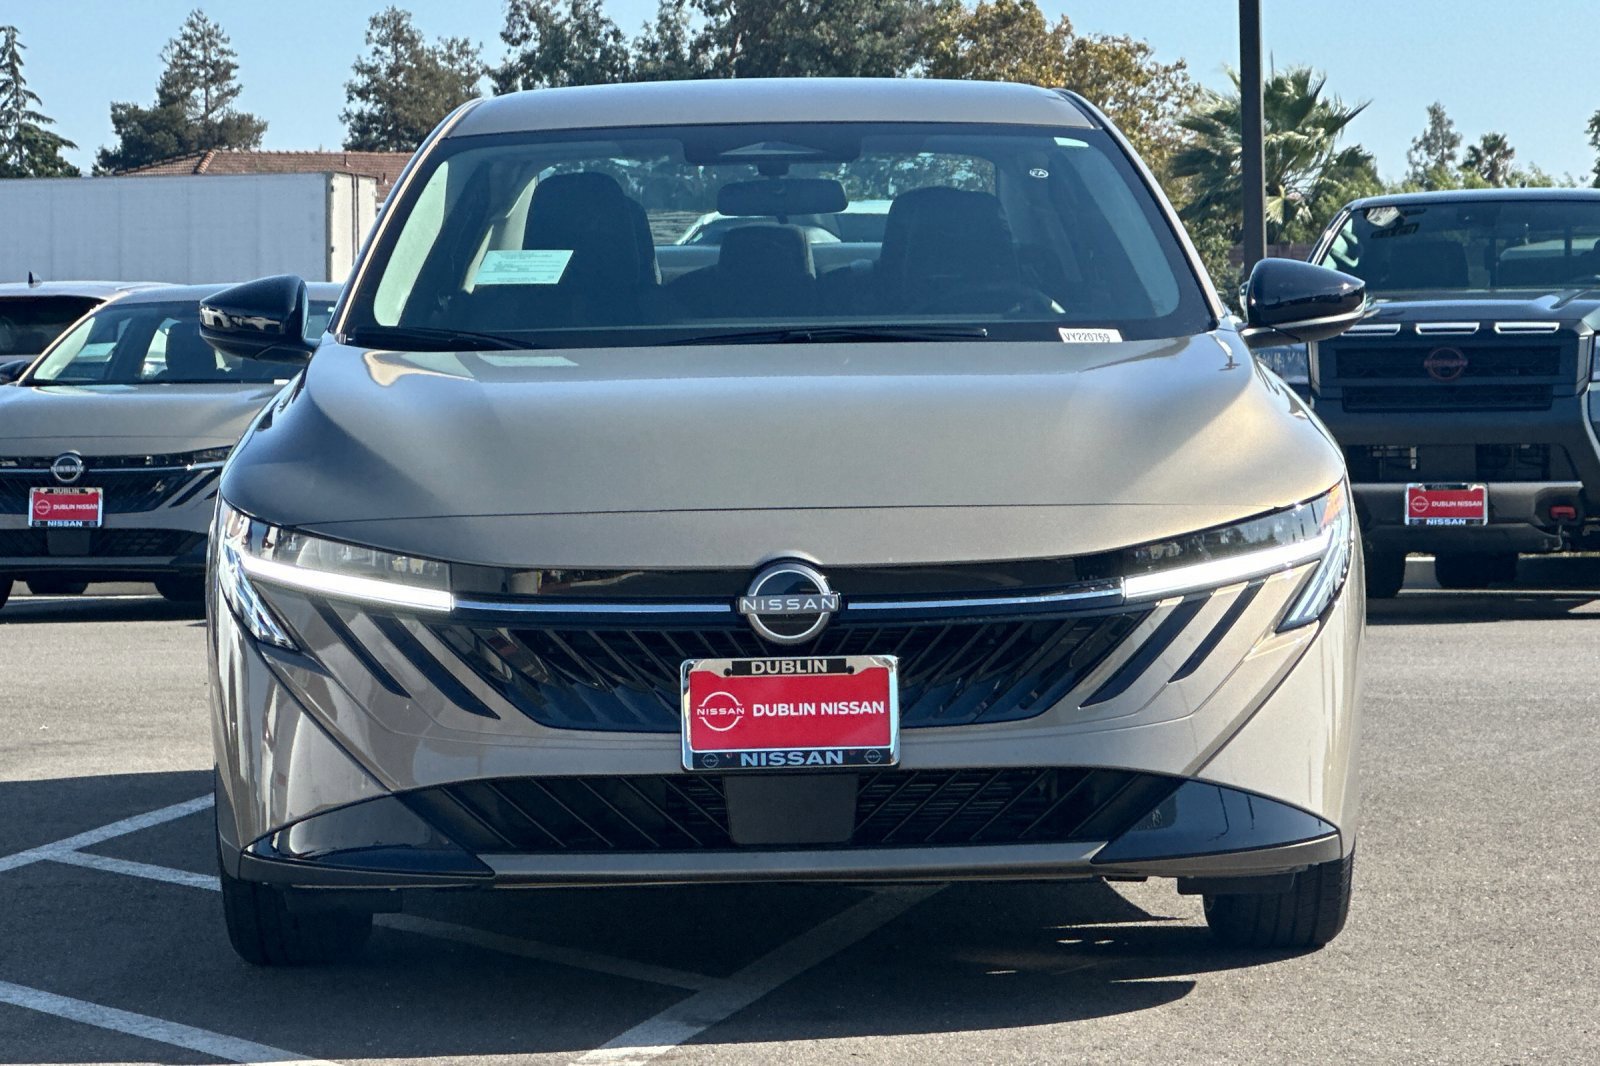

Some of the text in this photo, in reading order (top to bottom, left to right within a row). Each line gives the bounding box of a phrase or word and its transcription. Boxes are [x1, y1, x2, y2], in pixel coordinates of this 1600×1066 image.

[741, 597, 836, 612] NISSAN
[751, 659, 828, 675] DUBLIN
[697, 707, 745, 716] NISSAN
[752, 701, 885, 717] DUBLIN NISSAN
[740, 750, 844, 767] NISSAN
